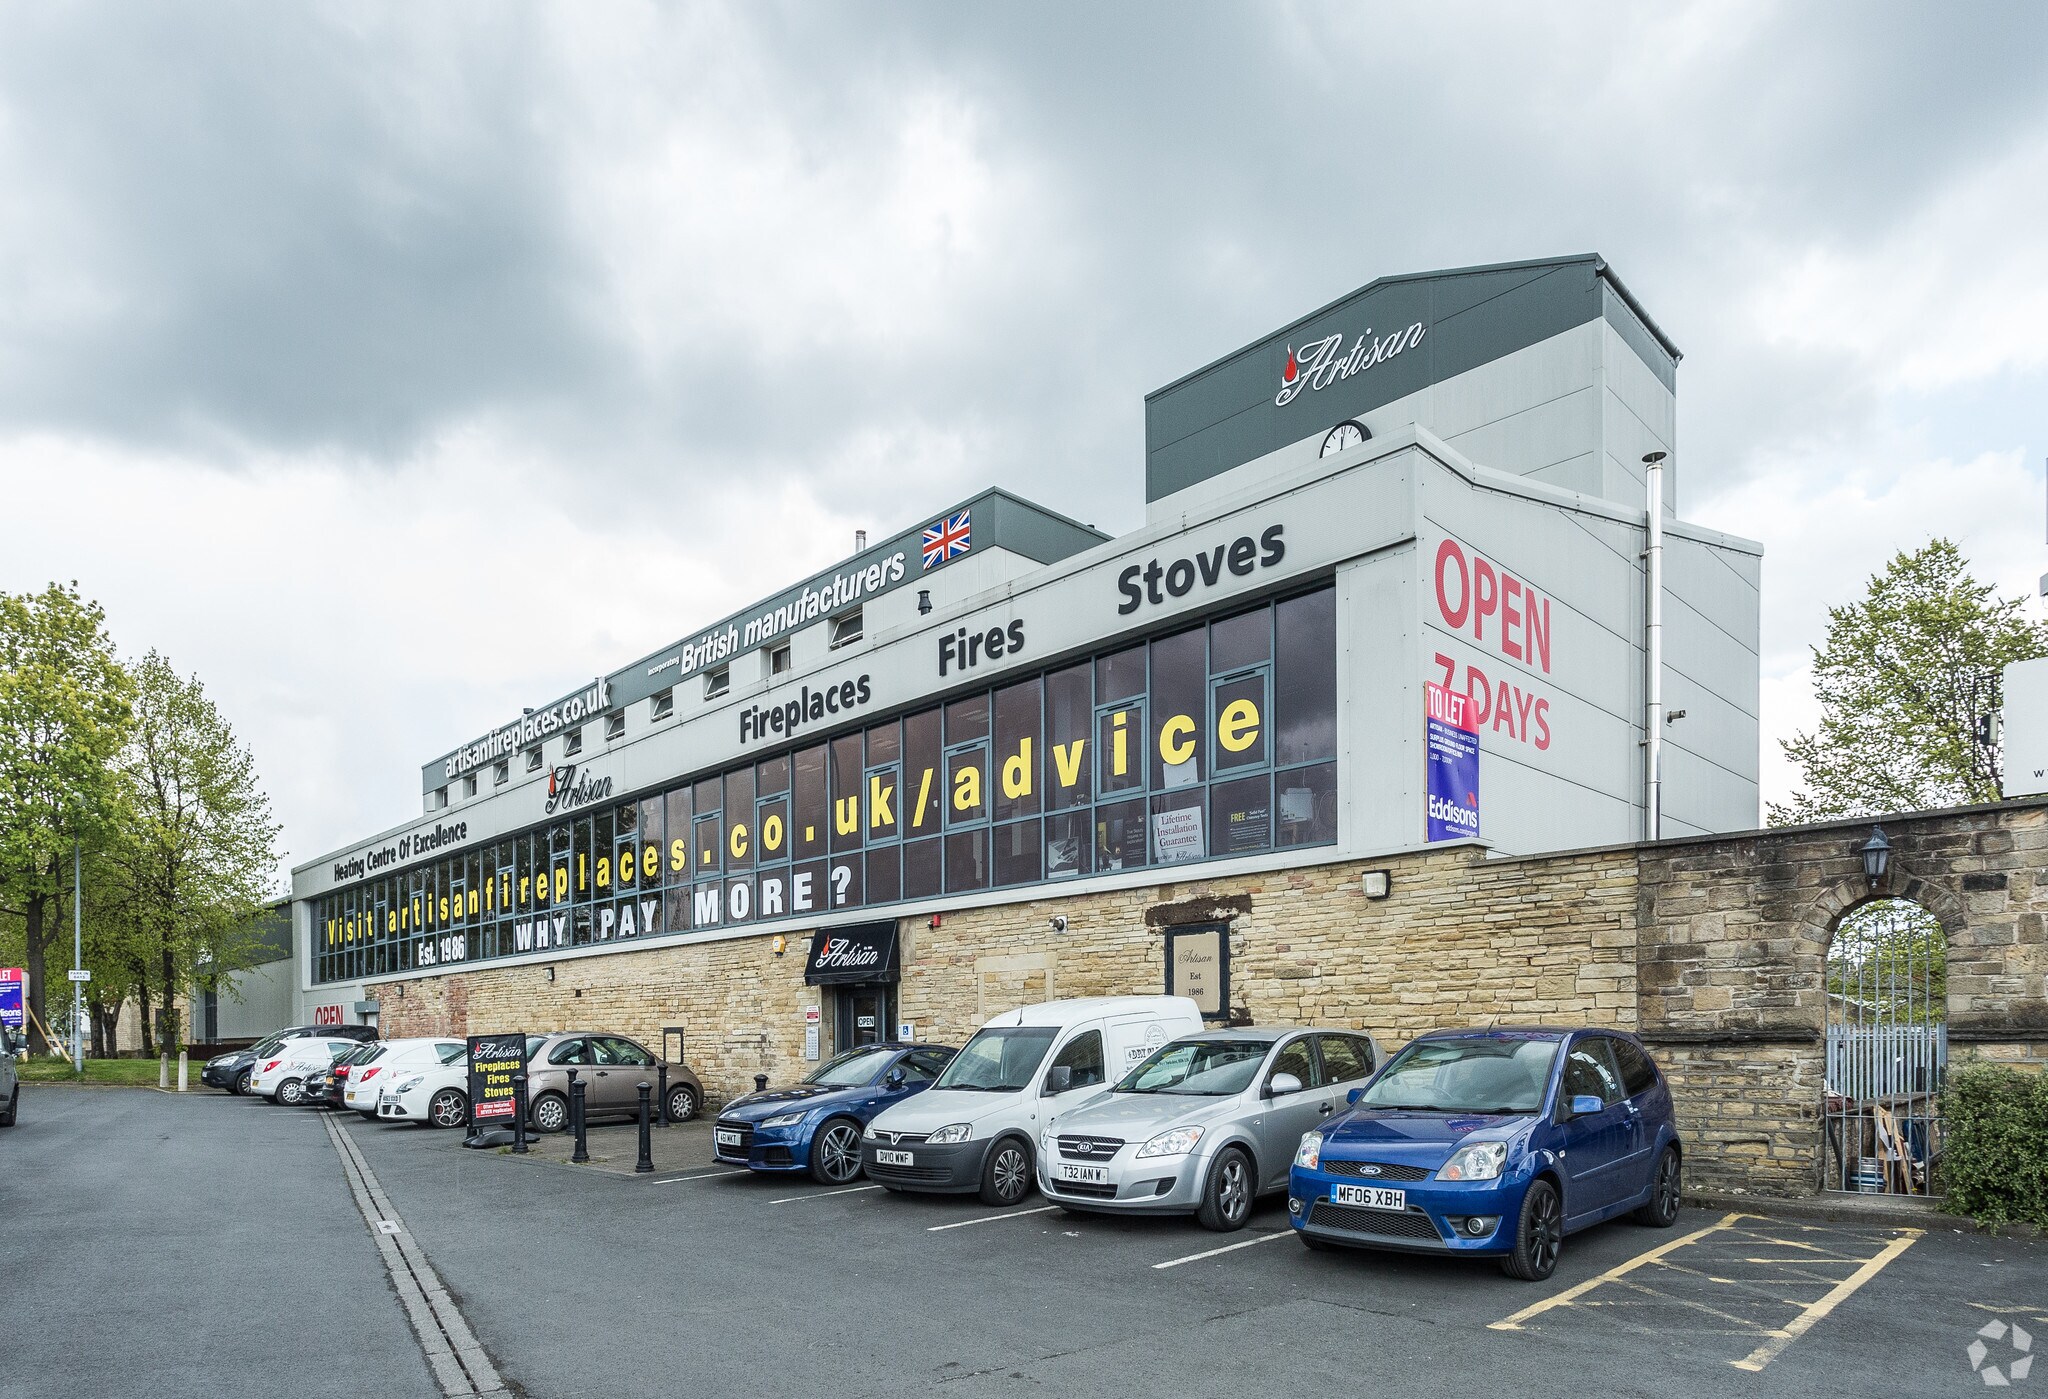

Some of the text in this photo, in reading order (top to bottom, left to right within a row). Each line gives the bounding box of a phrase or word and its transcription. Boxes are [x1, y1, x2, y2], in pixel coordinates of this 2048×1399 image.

[1275, 322, 1427, 407] Artisan
[1117, 524, 1285, 615] Stoves
[647, 552, 907, 676] incorporating British manufacturers
[1434, 538, 1551, 675] OPEN
[938, 618, 1024, 677] Fires
[739, 674, 871, 744] Fireplaces
[1428, 686, 1465, 726] TO LET
[1434, 651, 1551, 751] 7 DAYS
[445, 676, 612, 778] artisanfireplaces.co.uk
[545, 764, 613, 815] Artisan
[1160, 812, 1192, 826] Lifetime
[1230, 811, 1246, 823] FREE
[1429, 794, 1478, 828] Eddisons
[1156, 823, 1198, 837] Installation
[1159, 834, 1197, 848] Guarantee
[334, 820, 467, 882] Heating Centre Of Excellence
[327, 913, 374, 946] Visit
[515, 916, 566, 951] WHY
[600, 900, 657, 939] PAY
[418, 934, 465, 966] Est. 1986
[815, 938, 878, 968] Artisan
[1178, 949, 1213, 965] Artisan
[1190, 972, 1201, 980] Est
[1188, 988, 1204, 996] 1986
[315, 1005, 344, 1025] OPEN
[858, 1017, 874, 1026] OPEN
[472, 1042, 523, 1059] Artisan
[475, 1060, 520, 1072] Fireplaces
[484, 1087, 513, 1098] Stoves
[487, 1074, 510, 1085] Fires
[880, 1151, 894, 1162] DV10
[1064, 1166, 1078, 1179] T32
[1338, 1186, 1403, 1208] MF06 XBH
